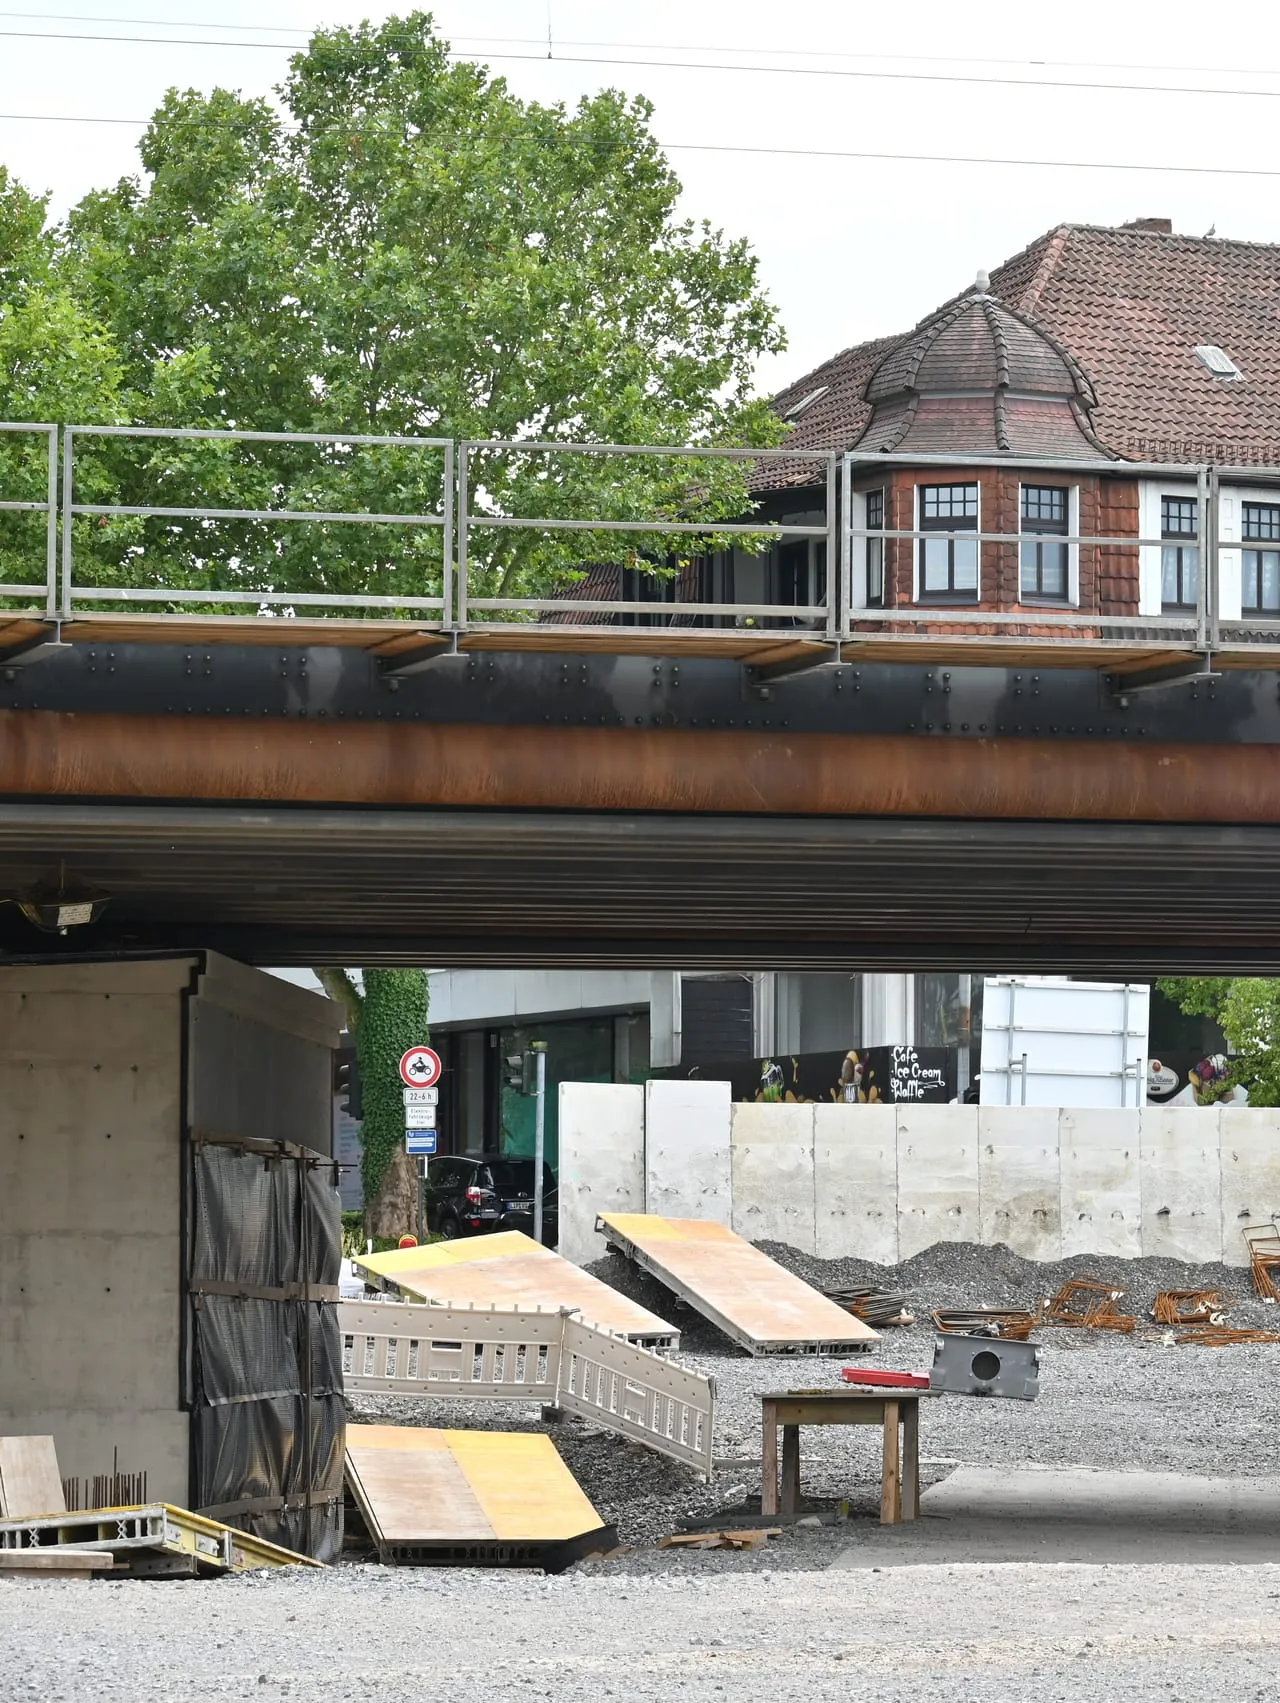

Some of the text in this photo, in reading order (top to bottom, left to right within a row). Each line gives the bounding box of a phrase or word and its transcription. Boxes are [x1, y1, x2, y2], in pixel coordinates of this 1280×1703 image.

[893, 1046, 918, 1065] Cafe
[894, 1061, 942, 1081] Ice Cream
[410, 1092, 426, 1101] 22-6
